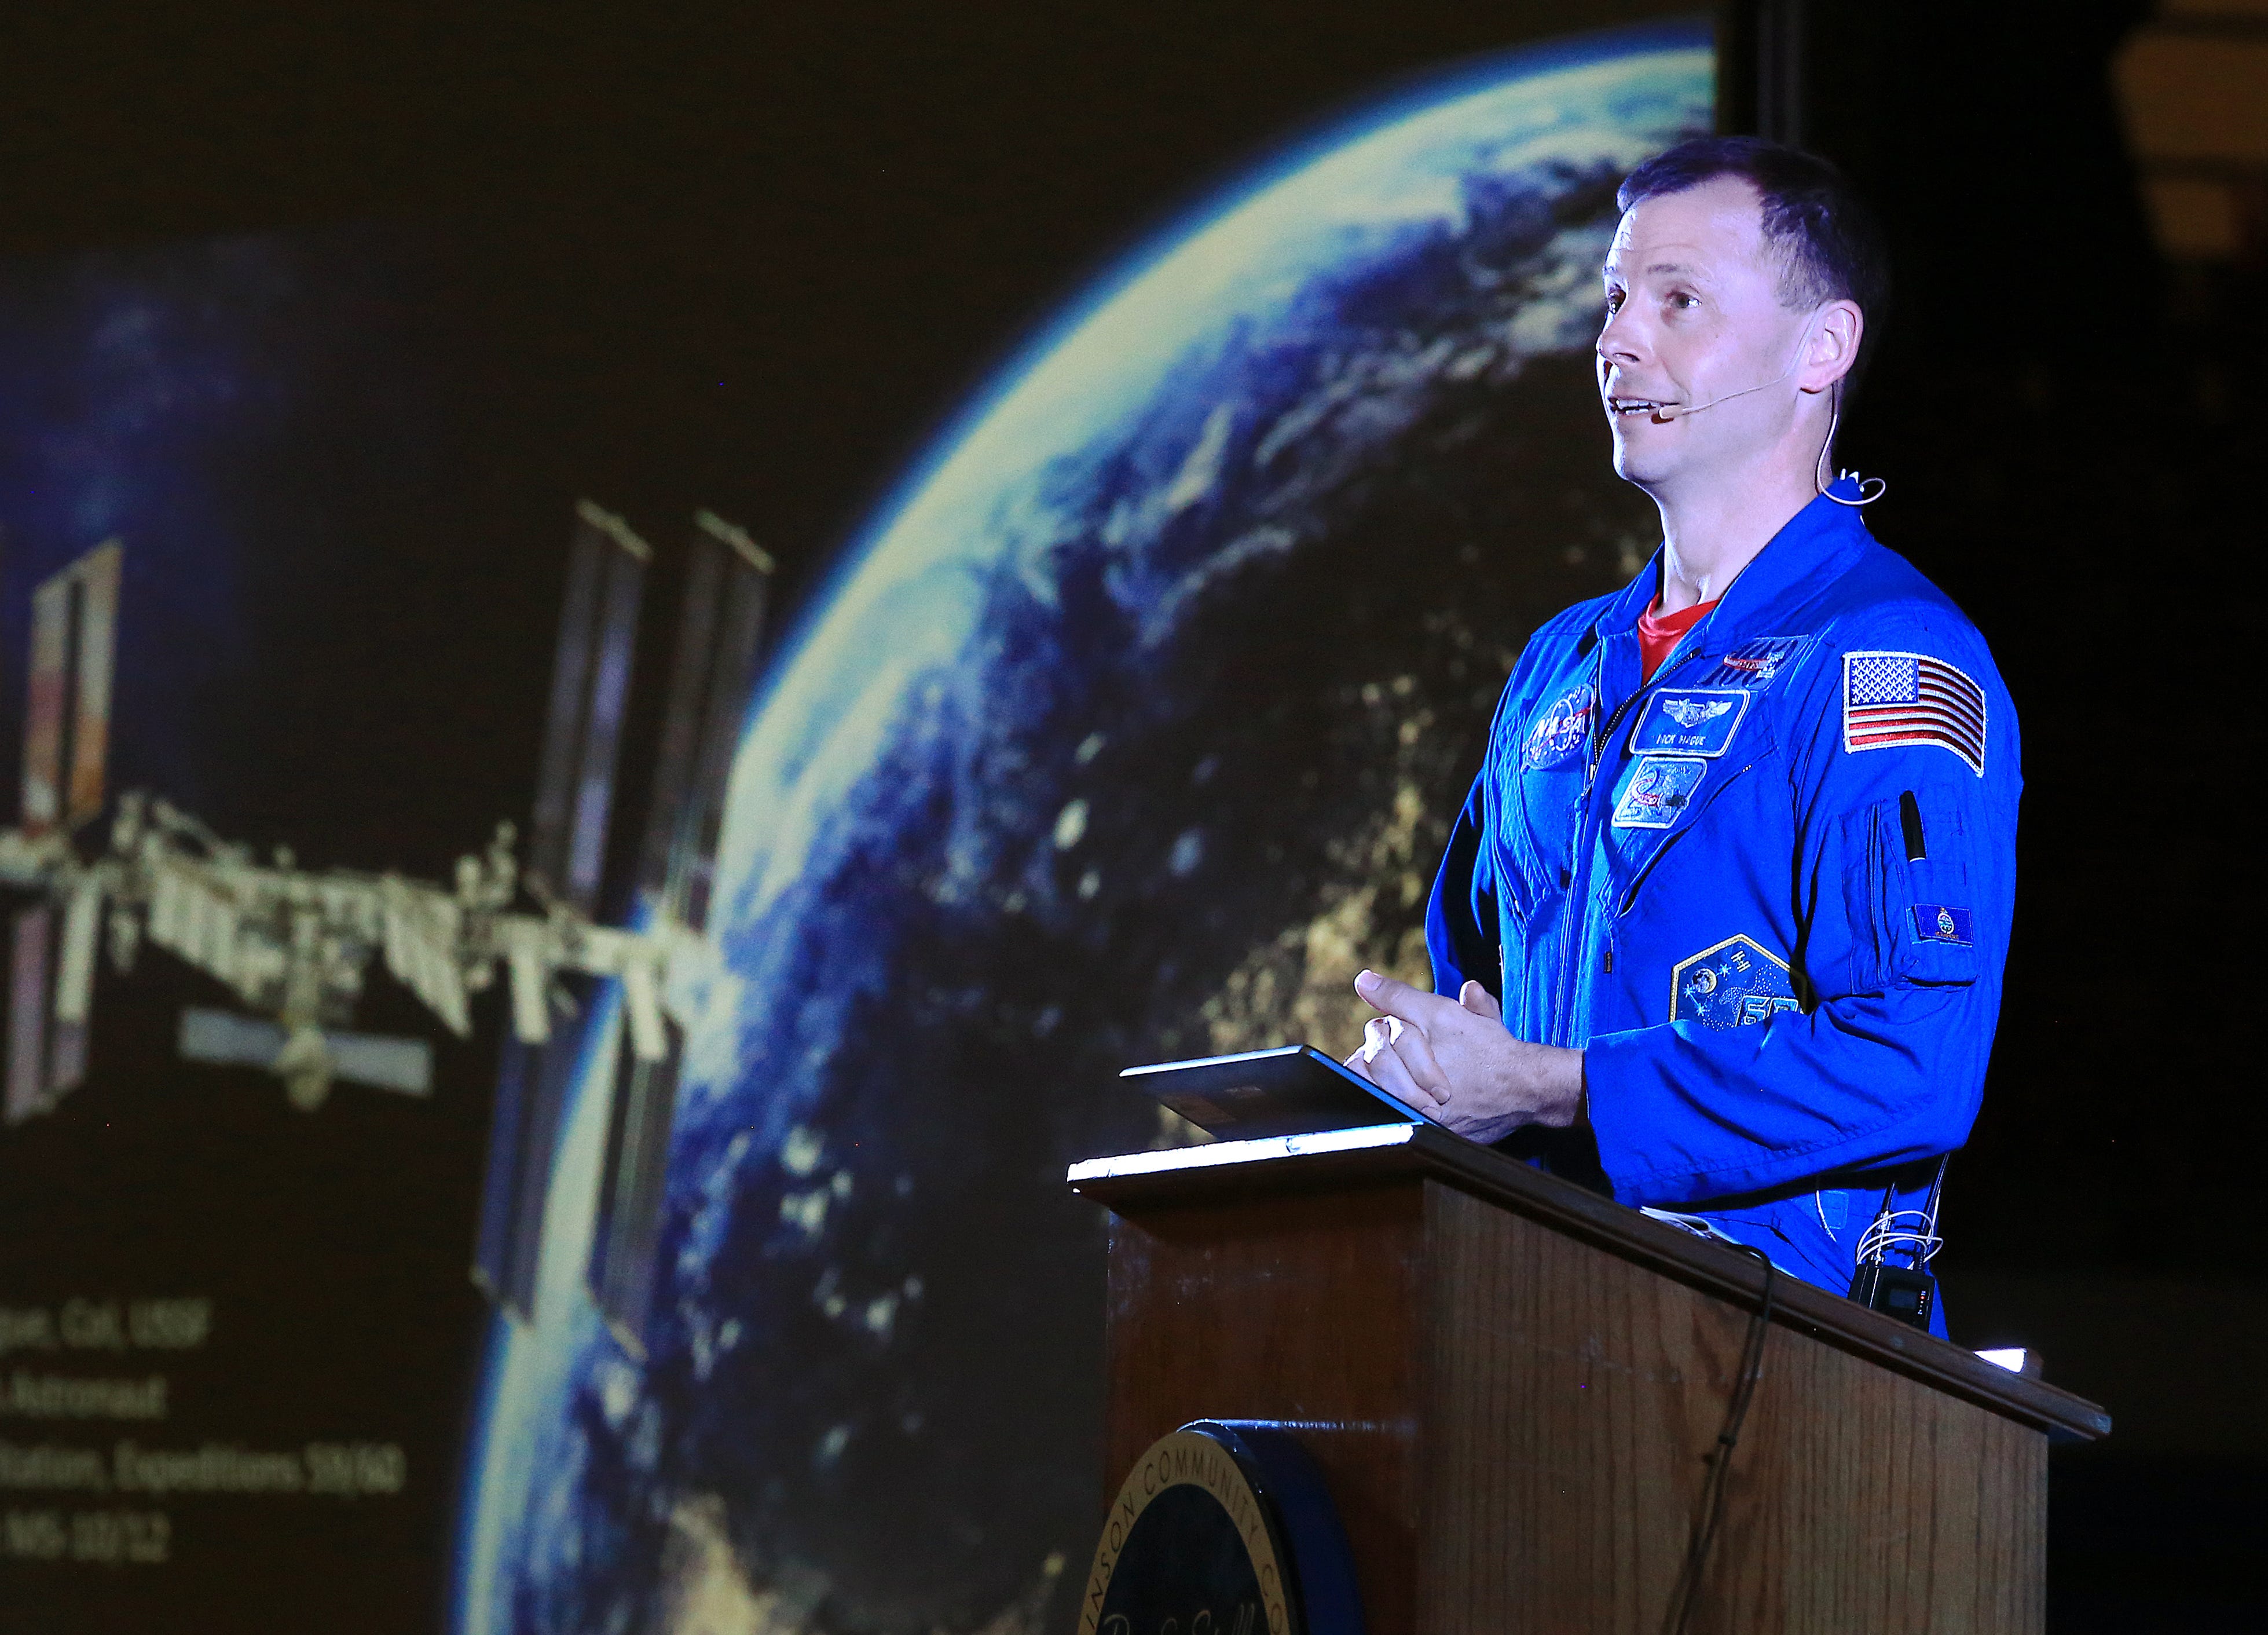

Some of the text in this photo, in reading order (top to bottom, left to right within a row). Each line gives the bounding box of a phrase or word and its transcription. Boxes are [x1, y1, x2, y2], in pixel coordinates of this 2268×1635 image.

[1532, 712, 1586, 740] NASA
[12, 1369, 167, 1419] Astronaut
[115, 1440, 299, 1498] Expeditions
[1144, 1449, 1259, 1545] COMMUNITY
